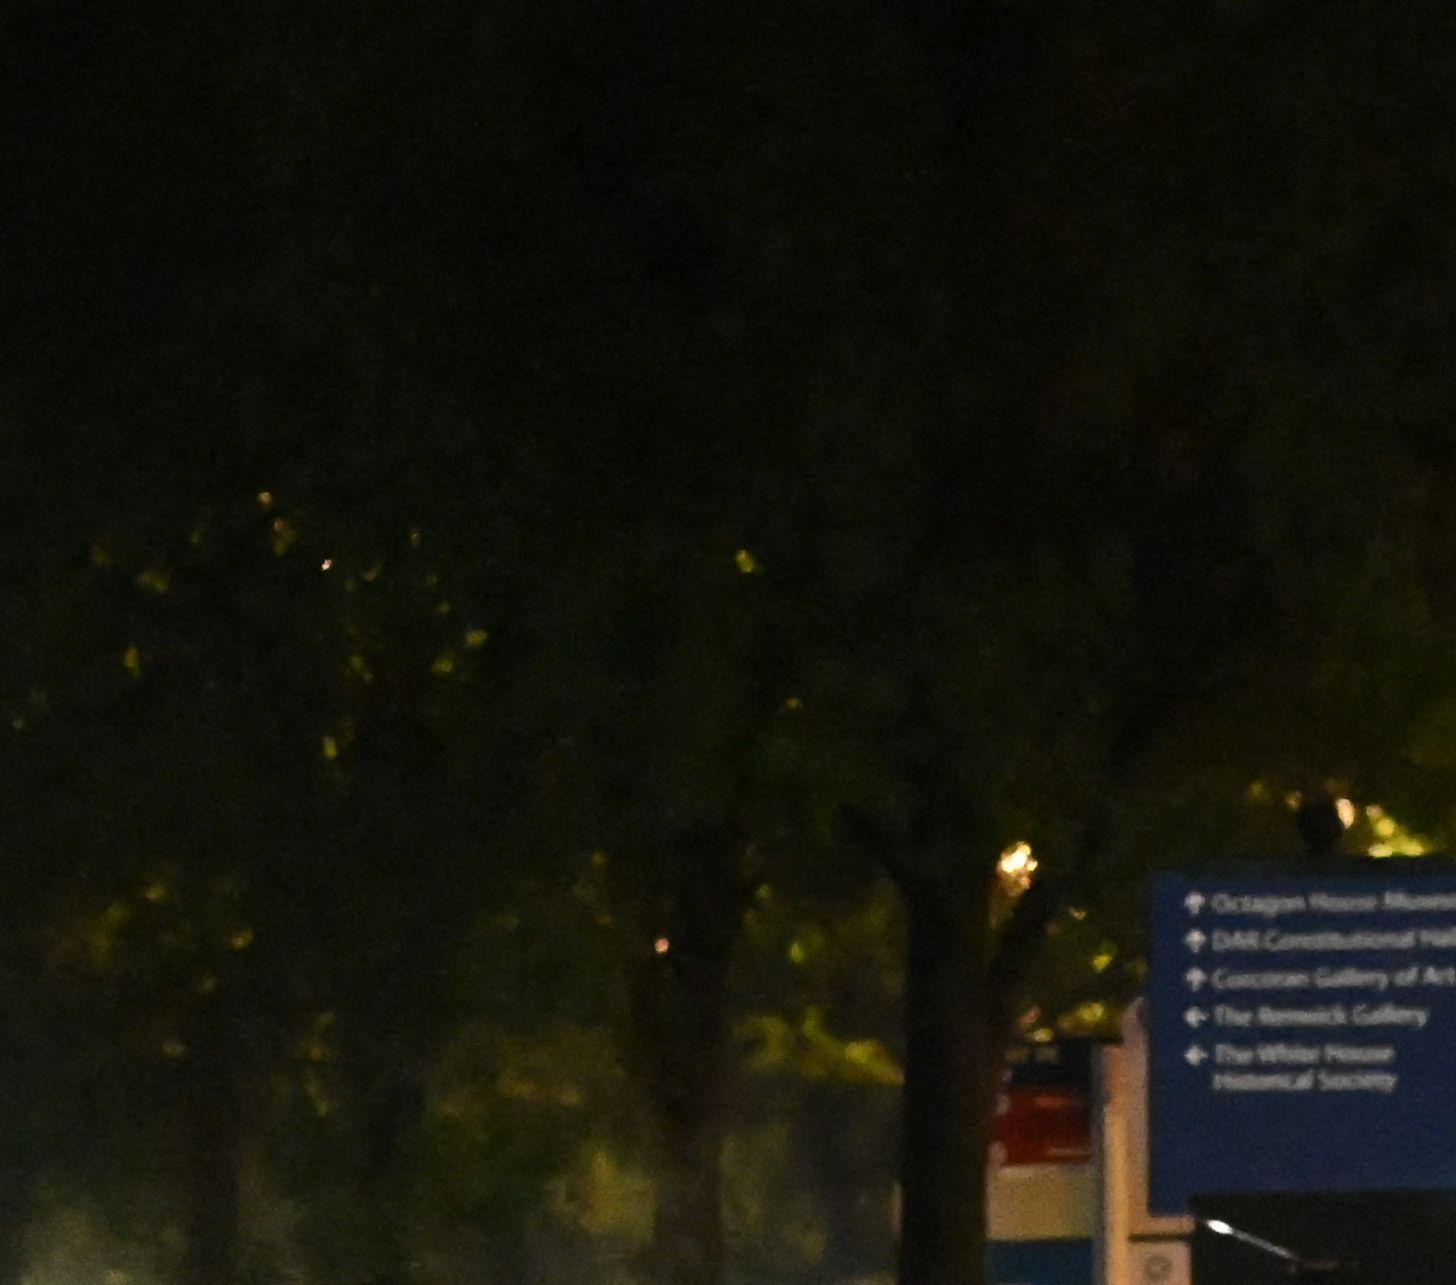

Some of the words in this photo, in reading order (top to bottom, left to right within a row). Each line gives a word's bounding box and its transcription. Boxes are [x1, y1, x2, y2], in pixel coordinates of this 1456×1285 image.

[1314, 967, 1388, 992] Gallery
[1393, 967, 1419, 987] of
[1423, 967, 1456, 986] Art
[1215, 1006, 1252, 1027] The
[1352, 1005, 1430, 1030] Gallery
[1215, 1045, 1254, 1065] The
[1257, 1044, 1320, 1064] White
[1323, 1044, 1394, 1063] House
